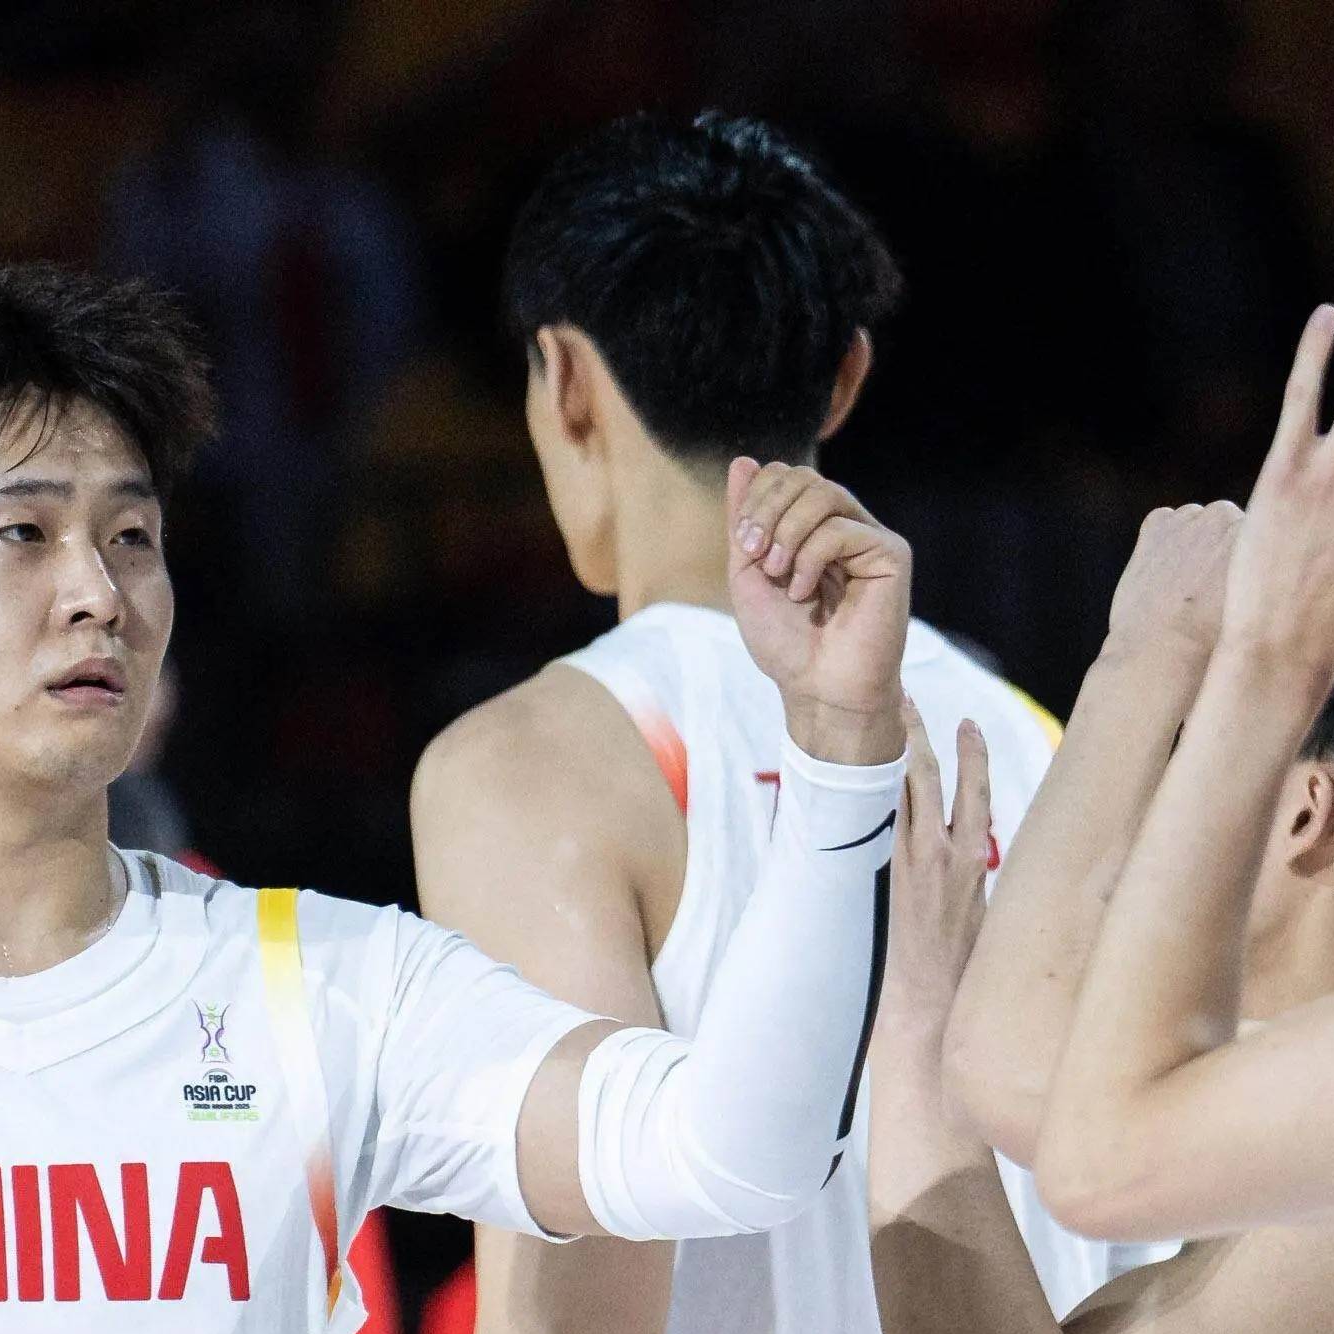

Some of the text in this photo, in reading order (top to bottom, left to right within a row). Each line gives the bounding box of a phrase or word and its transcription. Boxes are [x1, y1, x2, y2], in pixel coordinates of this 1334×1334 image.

[208, 1074, 228, 1083] FIBA
[183, 1085, 257, 1102] ASIA CUP
